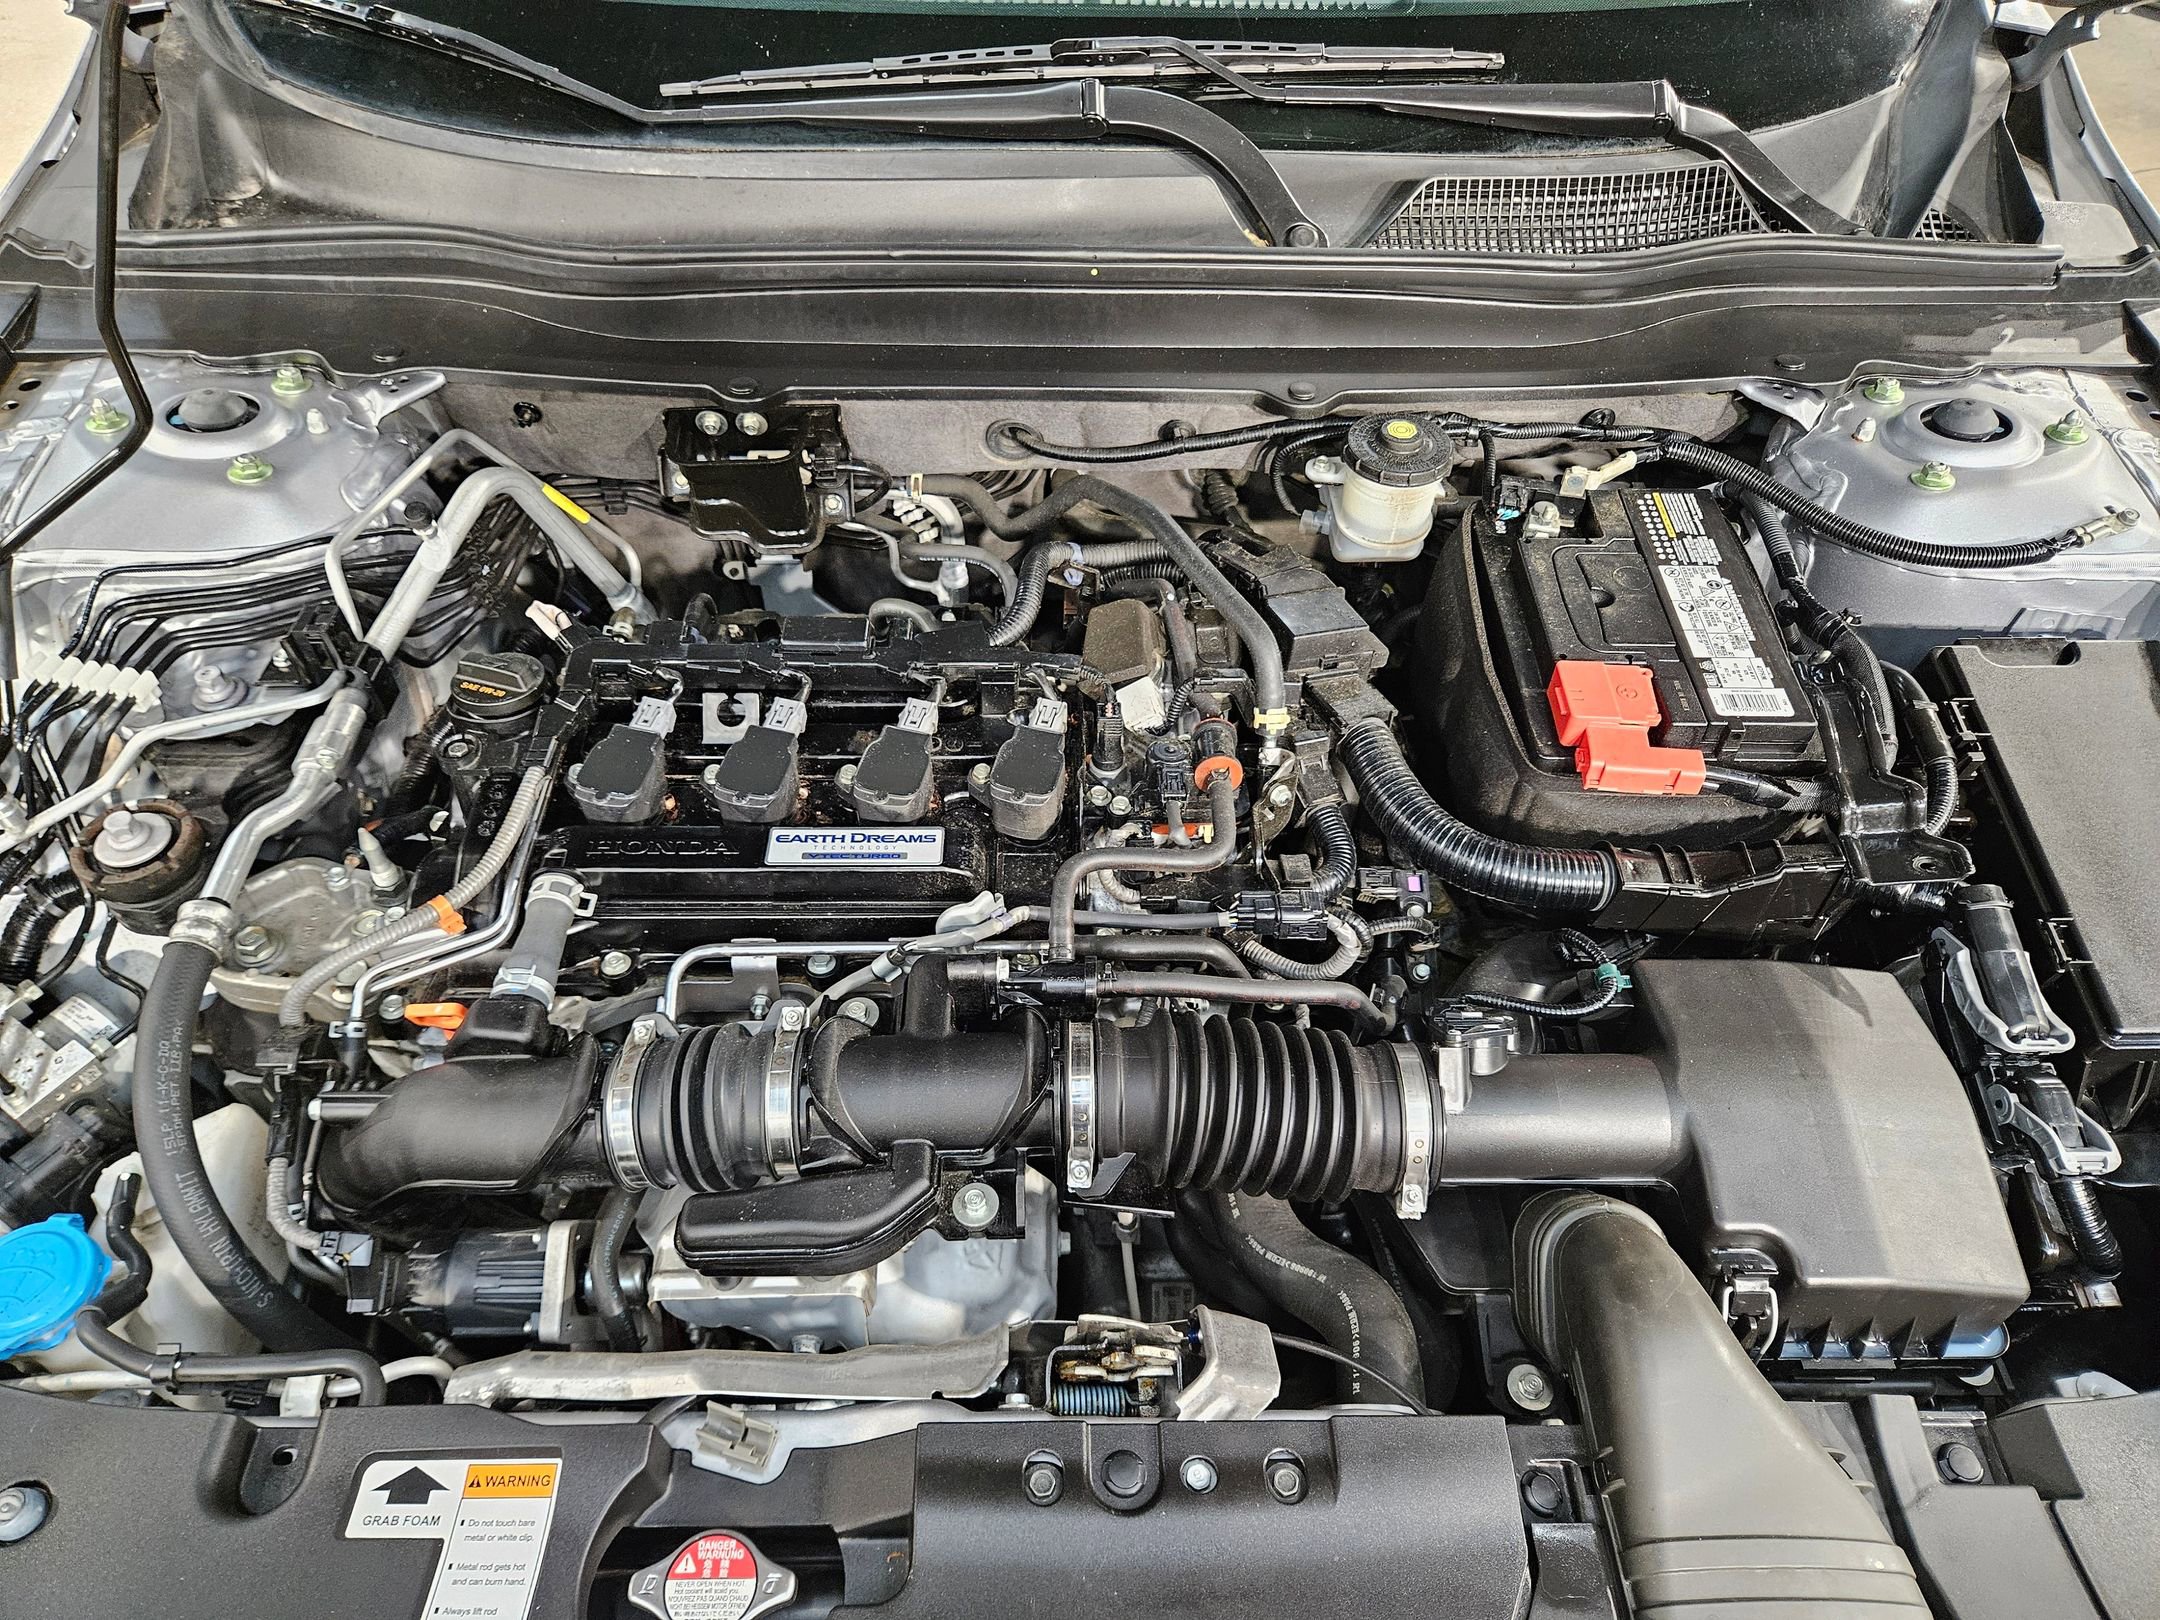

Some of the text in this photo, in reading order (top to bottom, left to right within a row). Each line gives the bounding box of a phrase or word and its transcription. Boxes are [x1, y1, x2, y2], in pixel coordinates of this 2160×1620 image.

[460, 681, 480, 692] SAE
[775, 833, 937, 843] EARTH DREAMS
[585, 840, 740, 855] HONDA
[485, 1475, 551, 1488] WARNING
[362, 1515, 441, 1526] GRAB FOAM
[468, 1519, 536, 1527] Do not touch bare
[464, 1534, 486, 1542] metal
[497, 1534, 518, 1542] white
[698, 1539, 737, 1551] DANGER
[698, 1549, 745, 1560] WARNUNG
[456, 1563, 525, 1573] Metal rod gets hot
[451, 1578, 467, 1586] and
[485, 1578, 503, 1586] burn
[442, 1607, 498, 1617] Always lift rod
